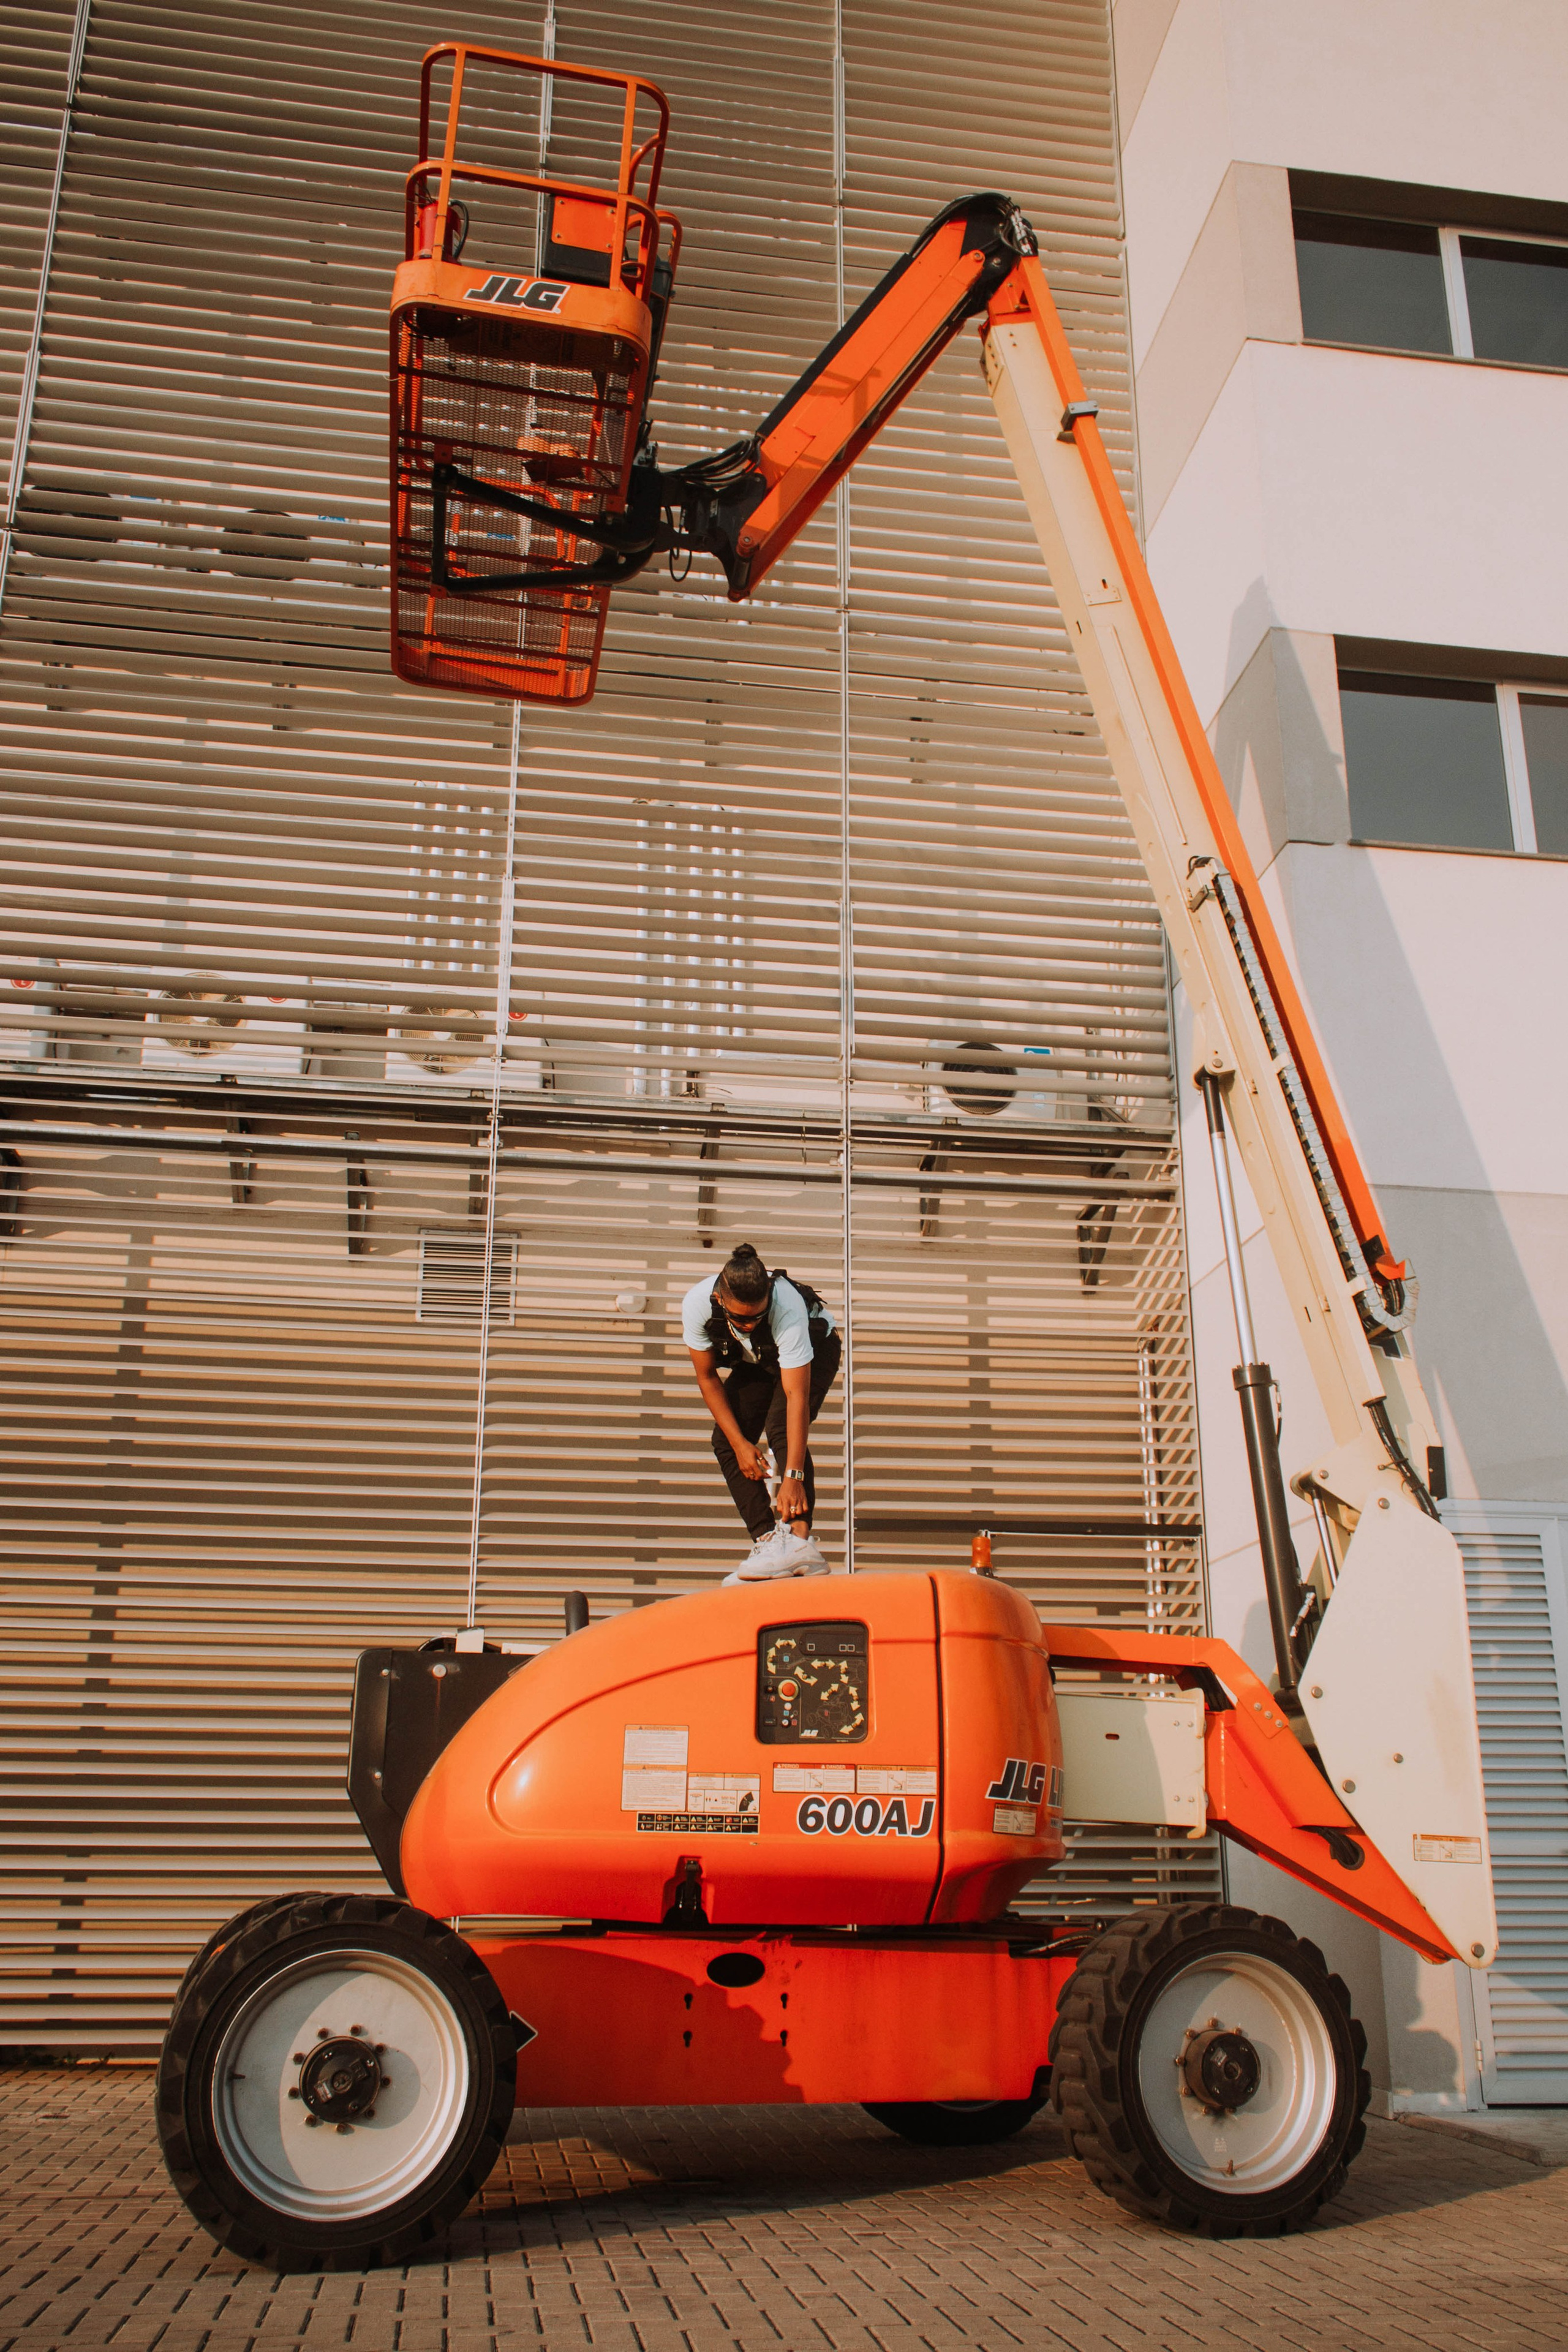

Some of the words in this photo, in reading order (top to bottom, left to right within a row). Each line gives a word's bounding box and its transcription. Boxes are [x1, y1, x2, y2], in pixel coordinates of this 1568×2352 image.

[463, 274, 570, 313] JLG
[985, 1758, 1046, 1804] JLG
[797, 1795, 936, 1837] 600AJ
